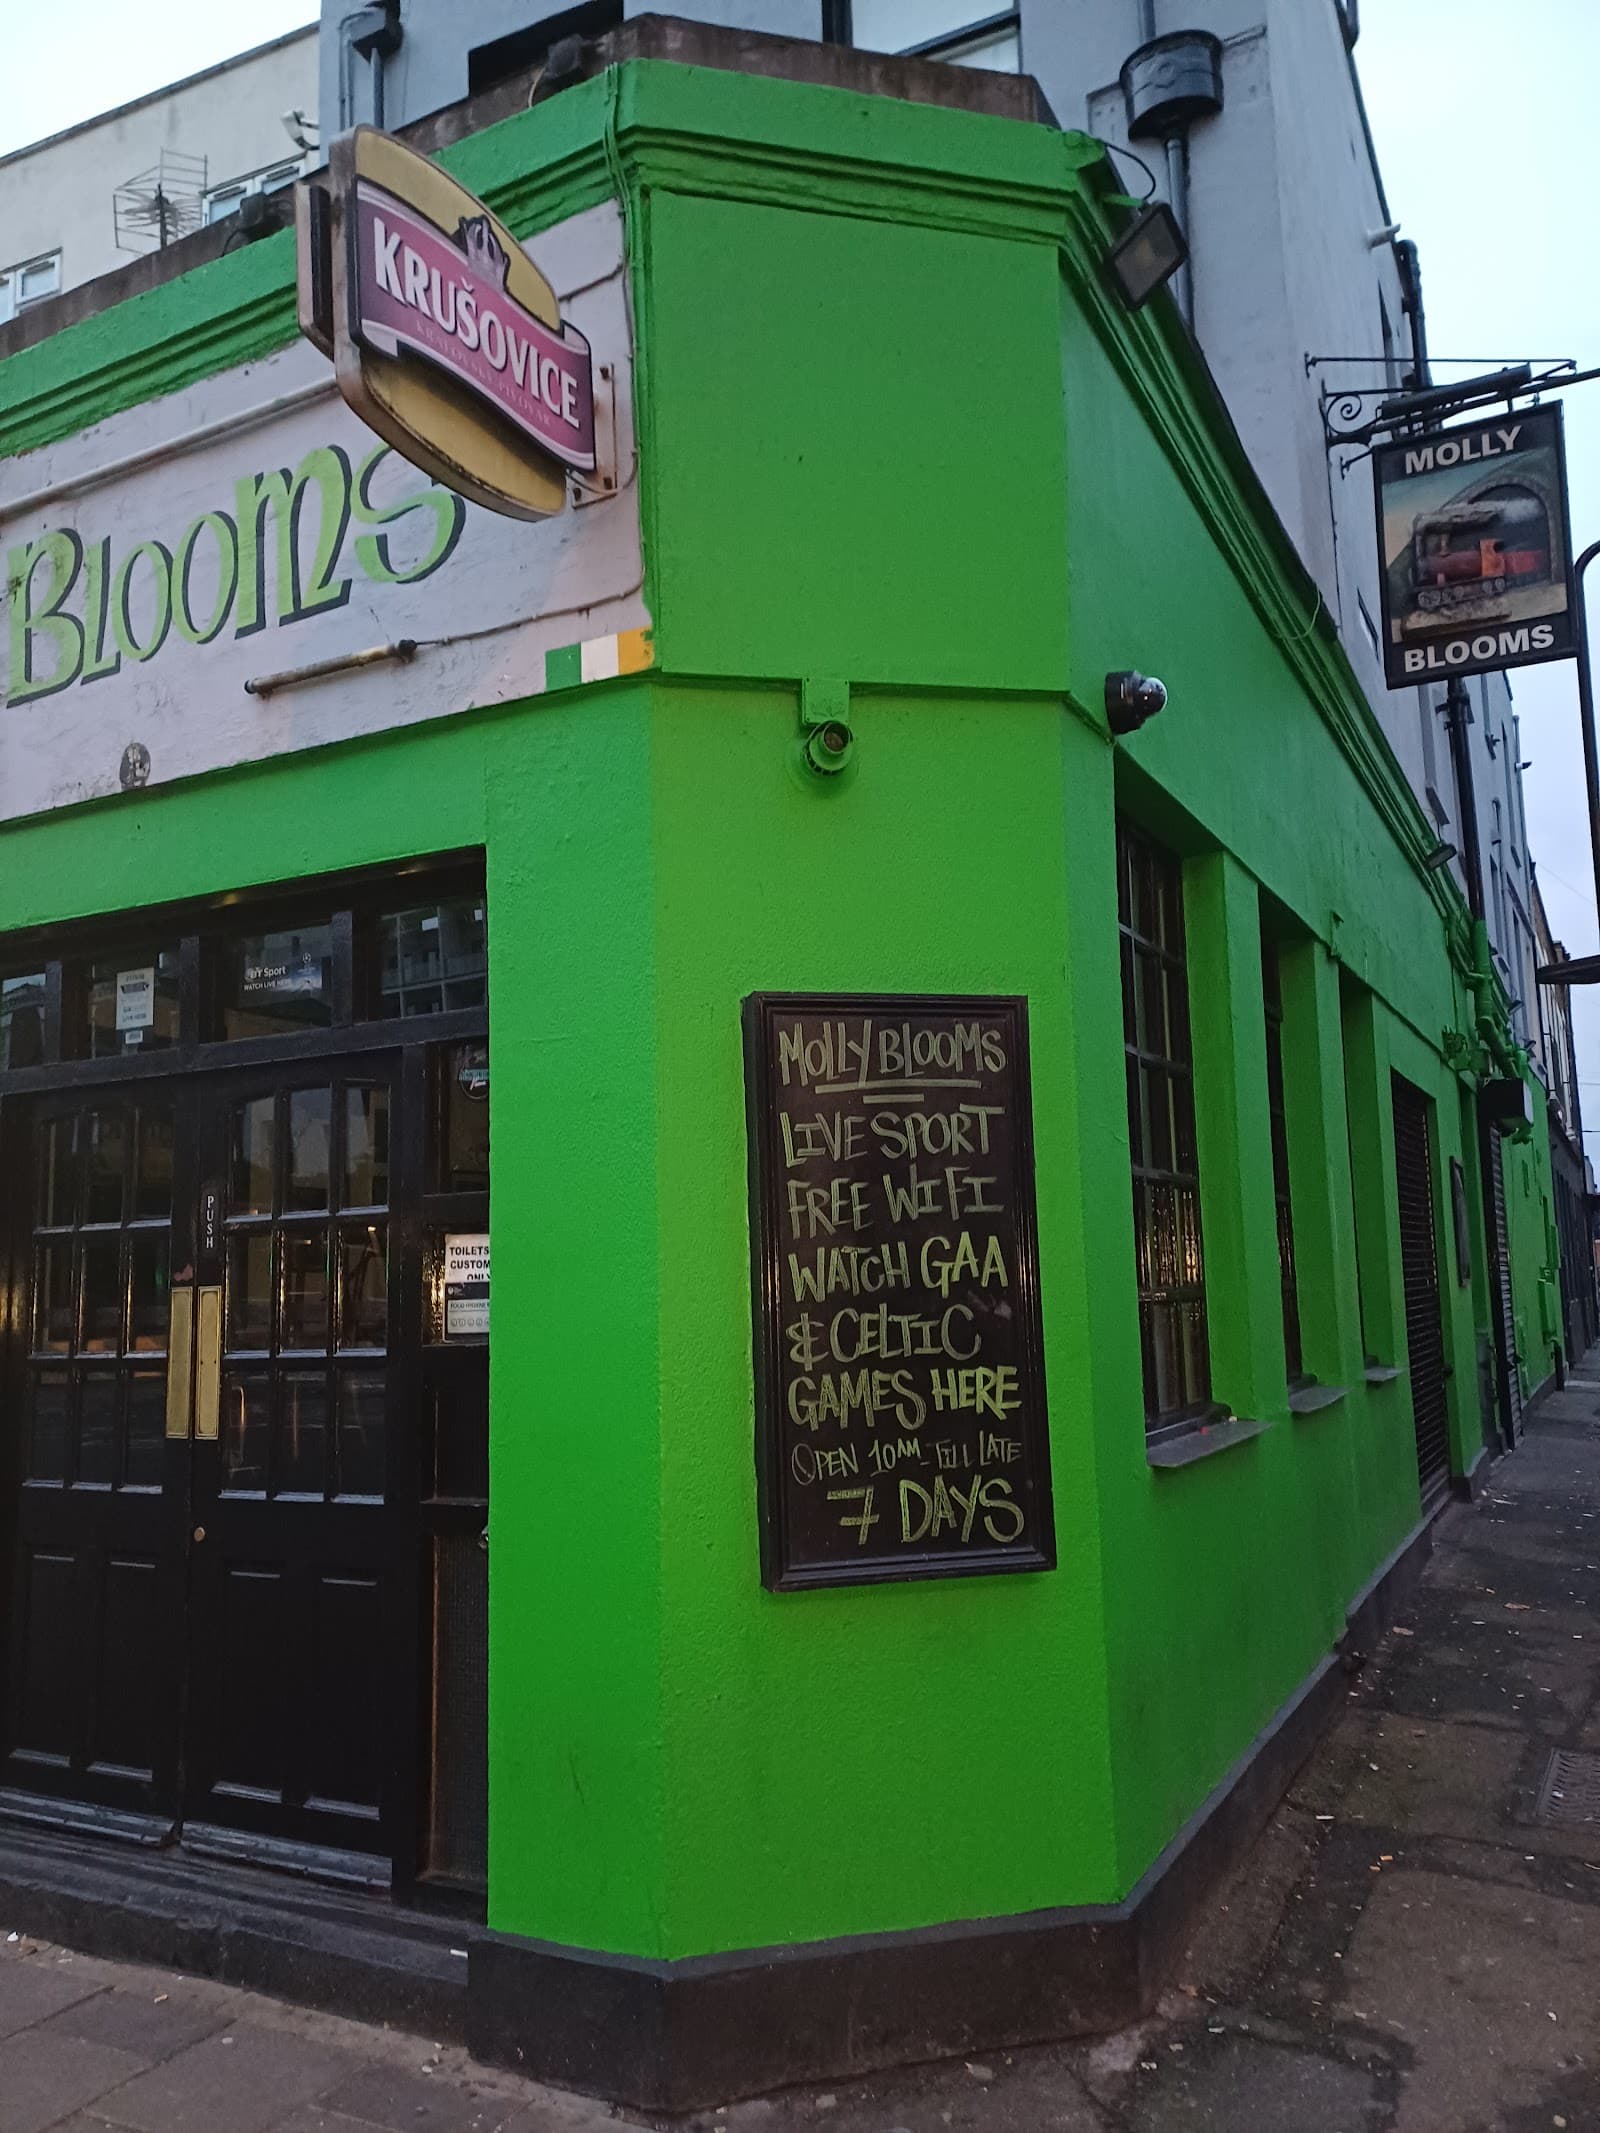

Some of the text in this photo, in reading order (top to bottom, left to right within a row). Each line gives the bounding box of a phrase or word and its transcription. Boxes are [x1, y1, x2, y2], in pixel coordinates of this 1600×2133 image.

[374, 217, 580, 430] KRUŠOVICE
[1404, 425, 1521, 475] MOLLY
[1404, 624, 1555, 673] BLOOMS
[243, 981, 263, 992] WATCH
[263, 966, 286, 978] Sport
[779, 1019, 1007, 1087] MOLLY BLOOMS
[780, 1103, 1006, 1168] LIVE SPORT
[206, 1195, 215, 1249] PUSH
[787, 1177, 873, 1240] FREE
[449, 1245, 489, 1256] TOILETS
[788, 1231, 1009, 1303] WATCH GAA
[786, 1303, 982, 1372] & CELTIC
[787, 1365, 1023, 1431] GAMES HERE
[791, 1442, 859, 1486] OPEN
[979, 1430, 1022, 1466] LATE
[826, 1474, 1025, 1545] 7 DAYS
